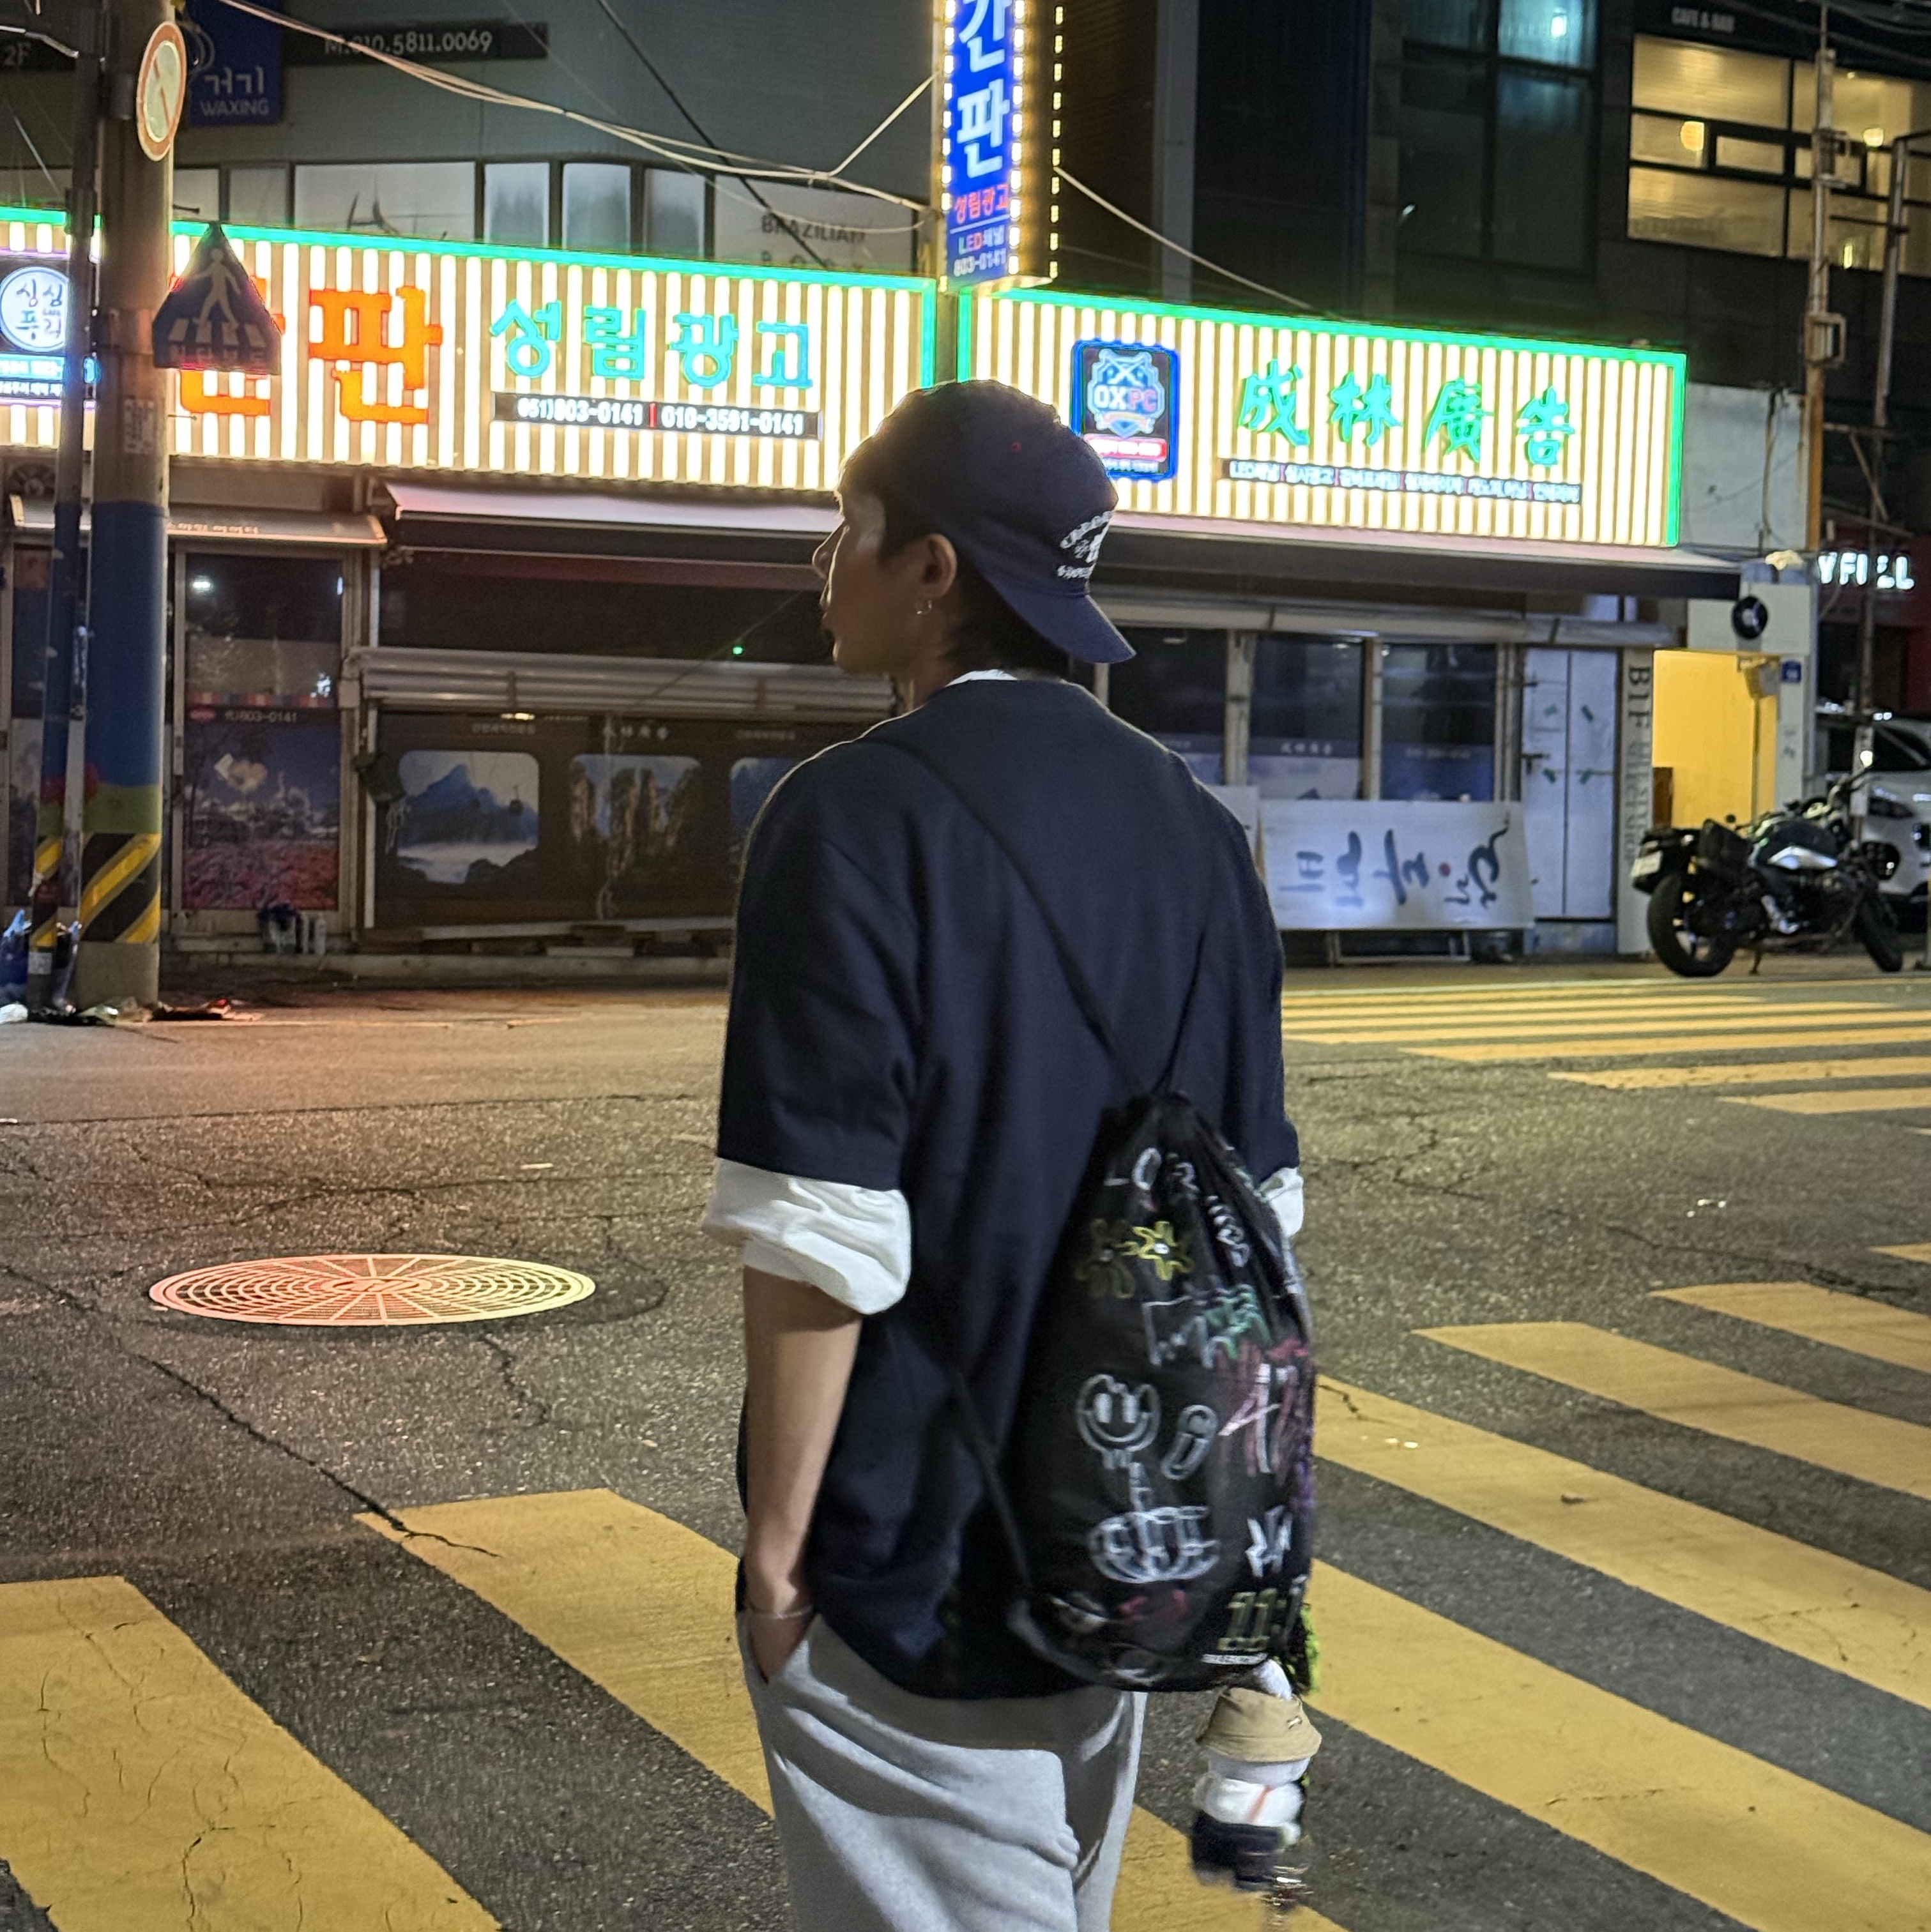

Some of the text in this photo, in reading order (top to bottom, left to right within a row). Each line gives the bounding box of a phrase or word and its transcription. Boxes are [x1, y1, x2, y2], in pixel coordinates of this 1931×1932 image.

[199, 99, 270, 118] WAXING
[956, 0, 1012, 179] 간판
[489, 298, 814, 389] 성림광고
